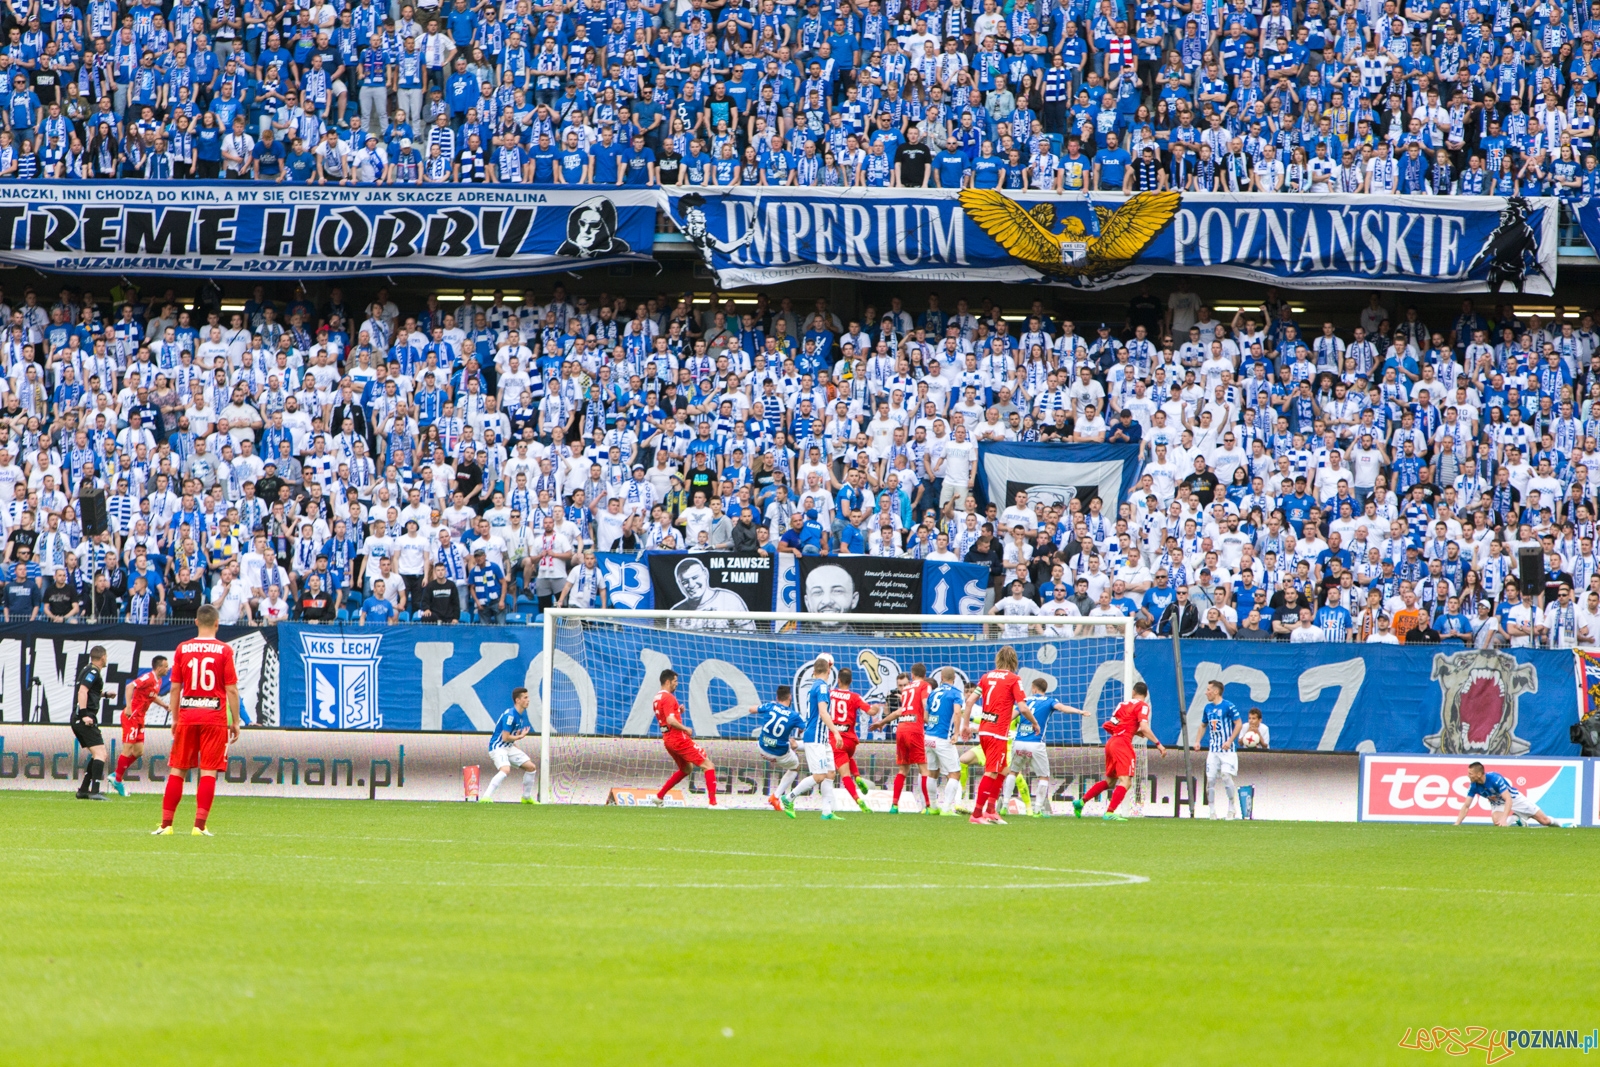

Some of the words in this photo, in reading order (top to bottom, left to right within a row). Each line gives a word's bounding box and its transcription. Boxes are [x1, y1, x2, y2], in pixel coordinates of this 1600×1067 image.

[0, 188, 58, 201] NACZKI,
[62, 189, 91, 200] INNI
[96, 189, 154, 203] CHODZĄ
[157, 189, 176, 200] DO
[181, 190, 219, 203] KINA,
[224, 191, 234, 201] A
[237, 191, 258, 202] MY
[263, 191, 285, 203] SIĘ
[288, 190, 361, 202] CIESZYMY
[364, 191, 392, 202] JAK
[396, 191, 453, 202] SKACZE
[457, 192, 548, 203] ADRENALINA
[260, 204, 538, 258] HOBBY
[721, 200, 971, 268] IMPERIUM
[1173, 205, 1467, 280] POZNAŃSKIE
[244, 259, 373, 273] POZNANIA
[709, 557, 726, 569] NA
[726, 557, 771, 569] ZAWSZE
[721, 571, 729, 583] Z
[730, 572, 759, 584] NAMI
[181, 643, 225, 655] BORYSIUK
[310, 642, 335, 655] KKS
[341, 643, 372, 656] LECH
[187, 657, 216, 691] 16
[901, 688, 916, 711] 22
[929, 691, 944, 713] 6
[986, 680, 997, 706] 7
[830, 698, 848, 722] 19
[129, 727, 138, 740] 21
[762, 711, 789, 738] 26
